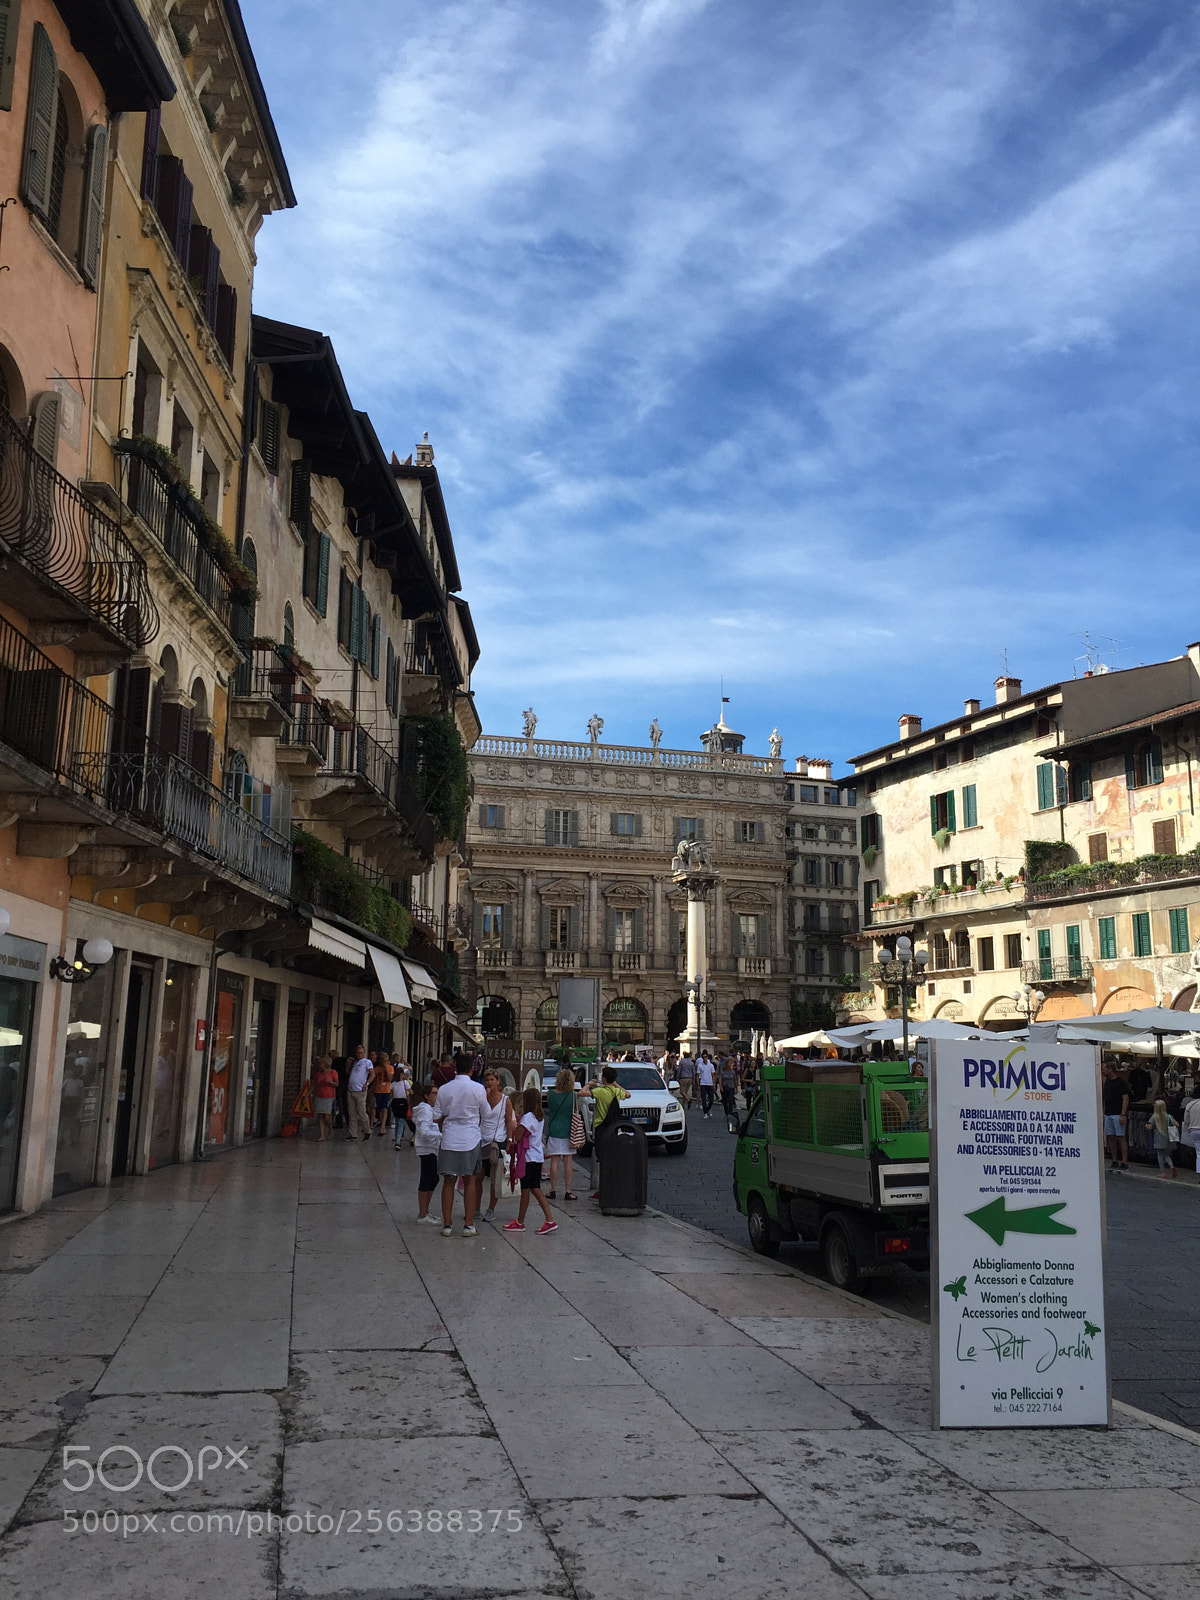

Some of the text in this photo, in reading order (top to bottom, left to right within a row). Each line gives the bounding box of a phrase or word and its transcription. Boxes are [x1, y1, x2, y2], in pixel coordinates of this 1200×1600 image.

[488, 1048, 520, 1059] VESPA
[524, 1049, 543, 1059] VESPA
[963, 1059, 1066, 1091] PRIMIGI
[1025, 1092, 1052, 1101] STORE
[960, 1109, 1077, 1122] ABBIGLIAMENTO, CALZATURE
[963, 1121, 1074, 1134] E ACCESSORI DA 0 A 14 ANNI
[975, 1134, 1062, 1145] CLOTHING, FOOTWEAR
[957, 1145, 974, 1154] AND
[976, 1145, 1031, 1156] ACCESSORIES
[1032, 1147, 1038, 1157] 0
[1044, 1147, 1053, 1157] 14
[1054, 1148, 1080, 1157] YEARS
[983, 1165, 1056, 1177] VIA PELLICCIAI, 22
[973, 1258, 1074, 1272] Abbigliamento Donna
[974, 1274, 1074, 1285] Accessori e Calzature
[981, 1292, 1067, 1307] Women's clothing
[962, 1307, 1086, 1319] Accessories and footwear
[957, 1324, 1093, 1373] Le Petit Jardin
[992, 1388, 1063, 1400] via Pellicciai 9
[1009, 1404, 1024, 1412] 045
[1027, 1404, 1041, 1412] 222
[1043, 1404, 1062, 1412] 7164
